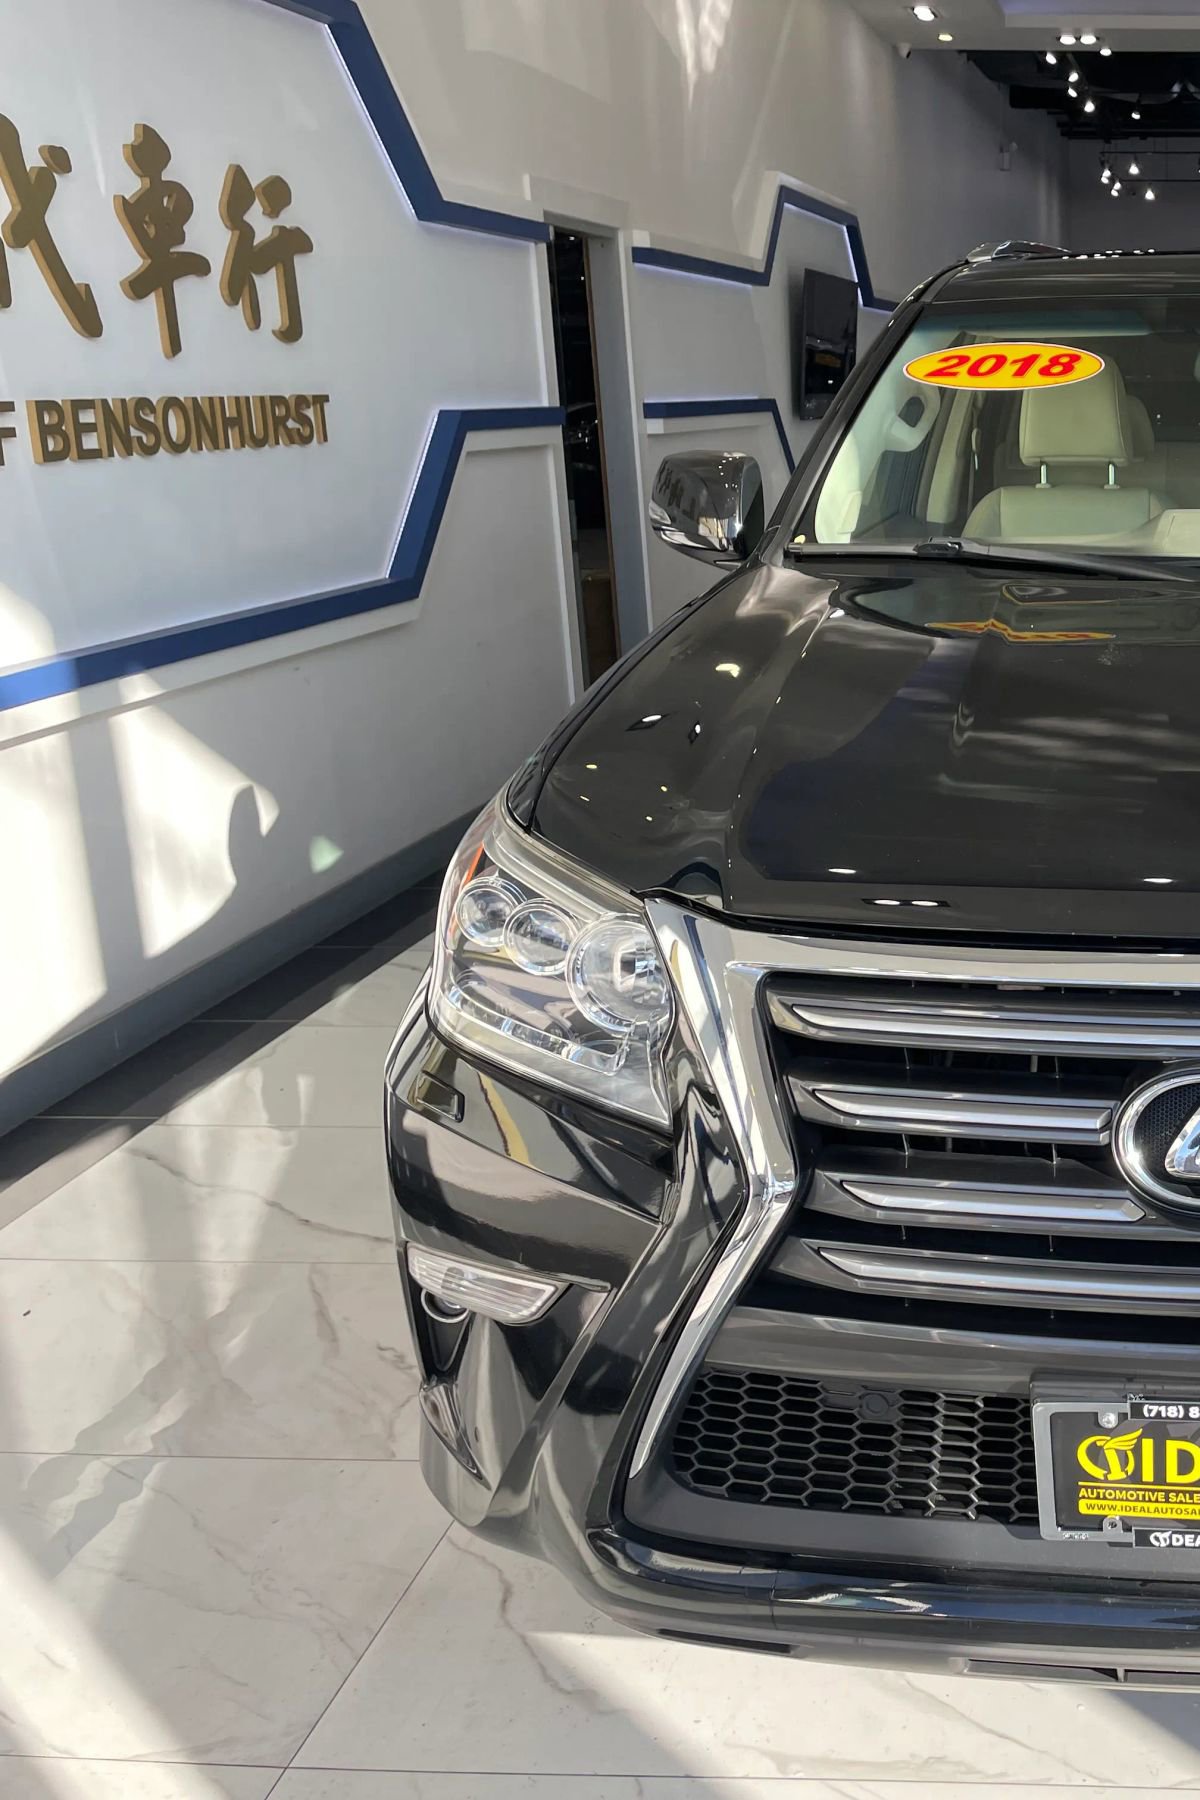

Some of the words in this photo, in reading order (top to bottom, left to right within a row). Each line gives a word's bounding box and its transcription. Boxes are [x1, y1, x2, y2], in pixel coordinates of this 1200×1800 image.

[924, 353, 1082, 378] 2018
[26, 395, 329, 464] BENSONHURST
[1143, 1404, 1184, 1418] (718)
[1079, 1487, 1165, 1502] AUTOMOTIVE
